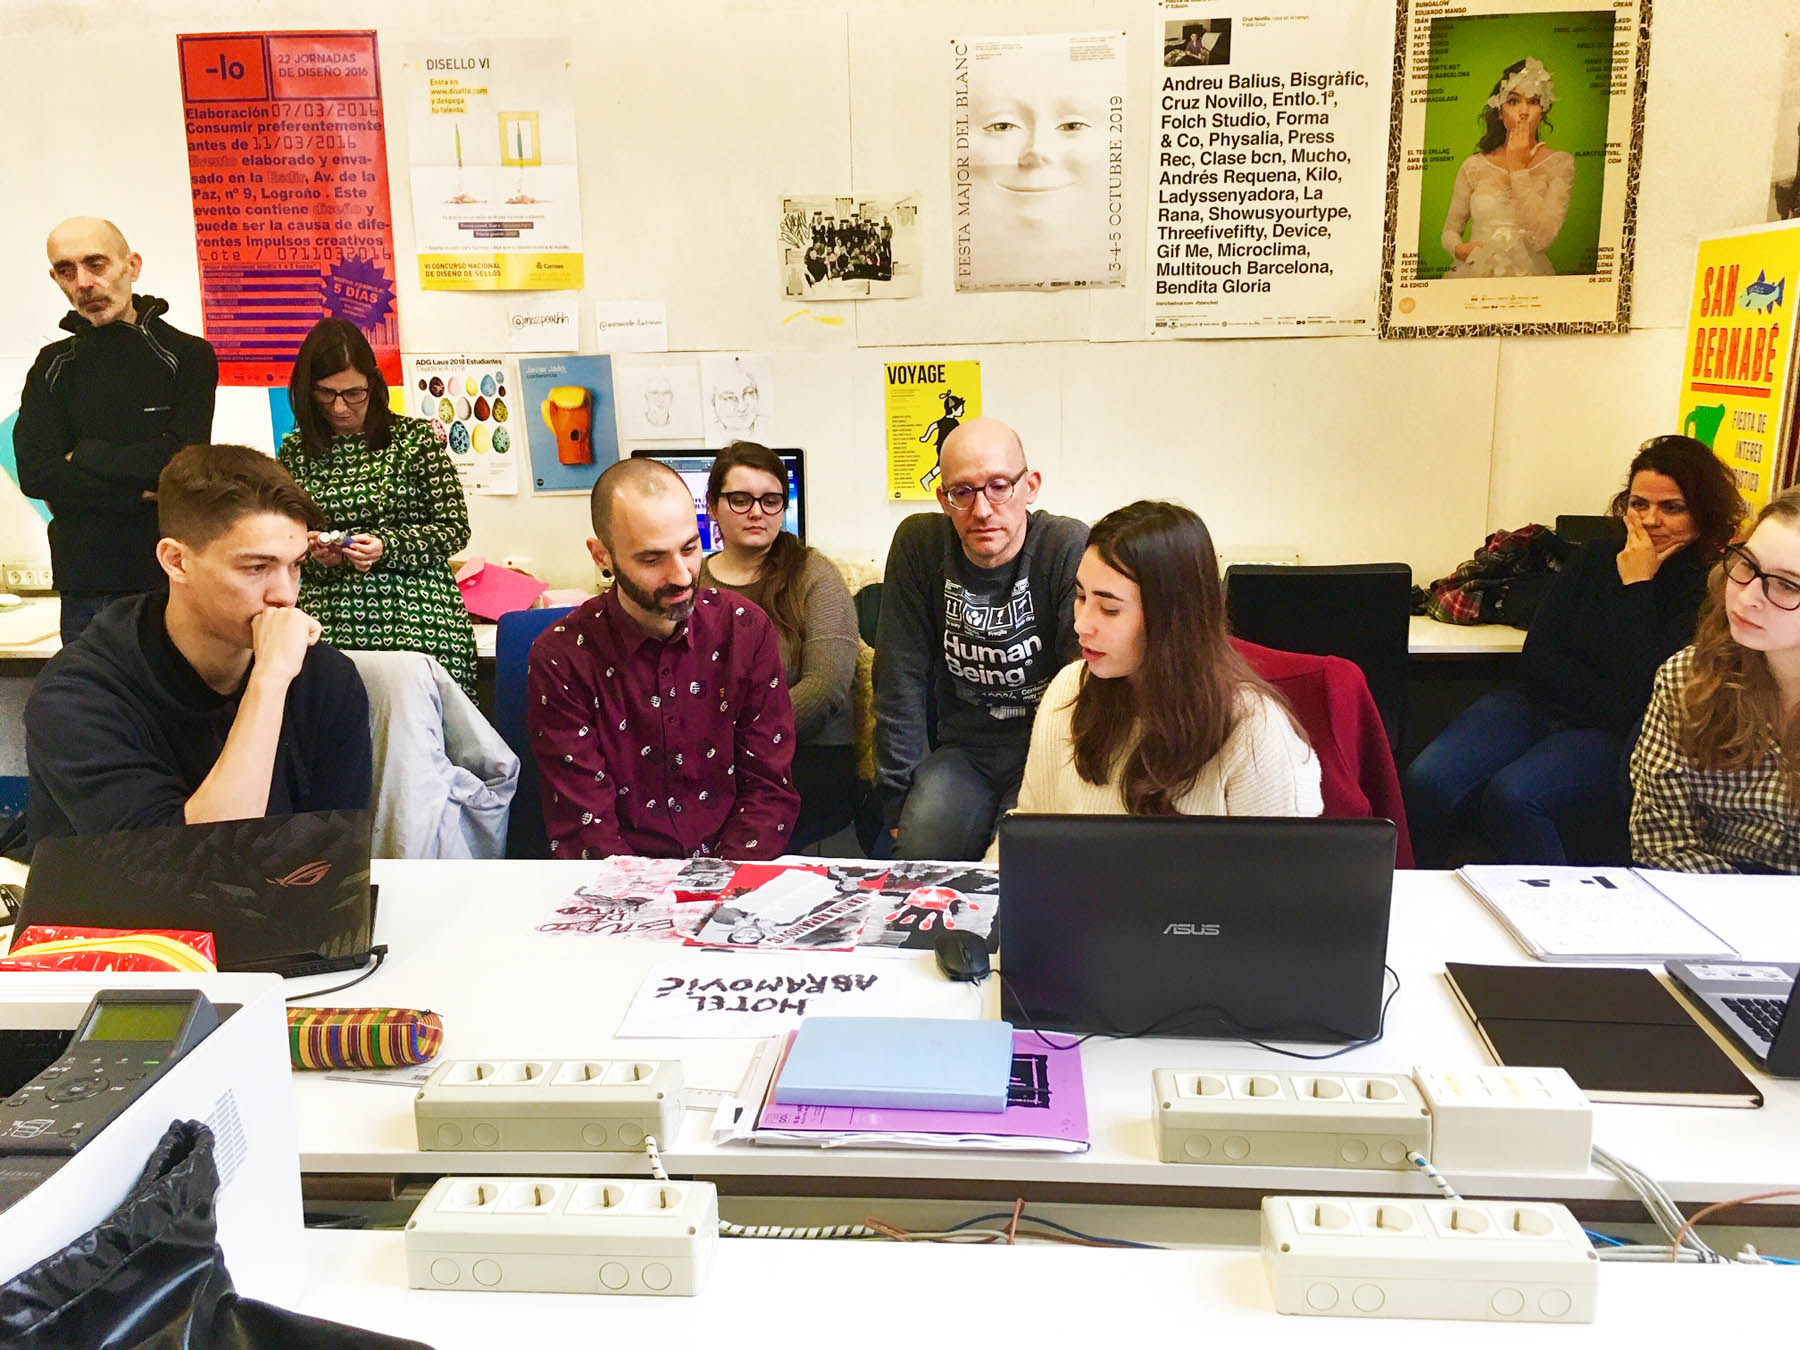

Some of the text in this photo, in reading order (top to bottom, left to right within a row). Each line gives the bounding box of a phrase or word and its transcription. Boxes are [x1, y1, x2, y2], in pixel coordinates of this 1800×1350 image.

[278, 54, 356, 64] 22 JORNADAS
[426, 58, 490, 70] DISELLO VI
[279, 65, 368, 77] DE DISEÑO 2016
[1162, 70, 1369, 92] Andreu Balius, Bisgràfic,
[1162, 95, 1199, 111] Cruz
[1205, 93, 1267, 110] Novillo,
[186, 103, 379, 120] Elaboración 07/03/2016
[1161, 111, 1329, 129] Folch Studio, Forma
[186, 121, 382, 135] Consumir preferentemente
[187, 136, 356, 150] antes de 11/03/2016
[1161, 130, 1335, 150] & Co, Physalia, Press
[242, 155, 315, 166] elaborado
[320, 156, 328, 168] y
[332, 156, 373, 165] enva-
[955, 43, 973, 277] FESTA MAJOR DEL BLANC
[1160, 148, 1351, 168] Rec, Clase bcn, Mucho,
[191, 171, 376, 184] sado en la Av. de la
[1108, 95, 1123, 271] 3-4-5 OCTUBRE 2019
[1160, 167, 1342, 186] Andrés Requena, Kilo,
[193, 190, 221, 202] Paz,
[243, 189, 257, 202] 9,
[334, 188, 367, 199] Este
[1159, 186, 1323, 207] Ladyssenyadora, La
[194, 205, 375, 217] evento contiene y
[1158, 205, 1352, 224] Rana, Showusyourtype,
[196, 218, 390, 233] puede ser la causa de dife-
[1158, 224, 1331, 242] Threefivefifty, Device,
[198, 236, 242, 247] rentes
[315, 235, 384, 247] creativos
[1157, 242, 1311, 260] Gif Me, Microclima,
[1156, 260, 1334, 277] Multitouch Barcelona,
[334, 284, 341, 295] 5
[346, 286, 379, 304] DÍAS
[1156, 278, 1271, 295] Bendita Gloria
[1700, 264, 1740, 318] SAN
[1692, 322, 1779, 383] BERNABÉ
[888, 364, 946, 385] VOYAGE
[988, 629, 1008, 637] Fragile
[944, 632, 1042, 664] Human
[945, 652, 1026, 687] Being
[1163, 924, 1220, 936] ASUS
[688, 996, 810, 1016] HOTEL
